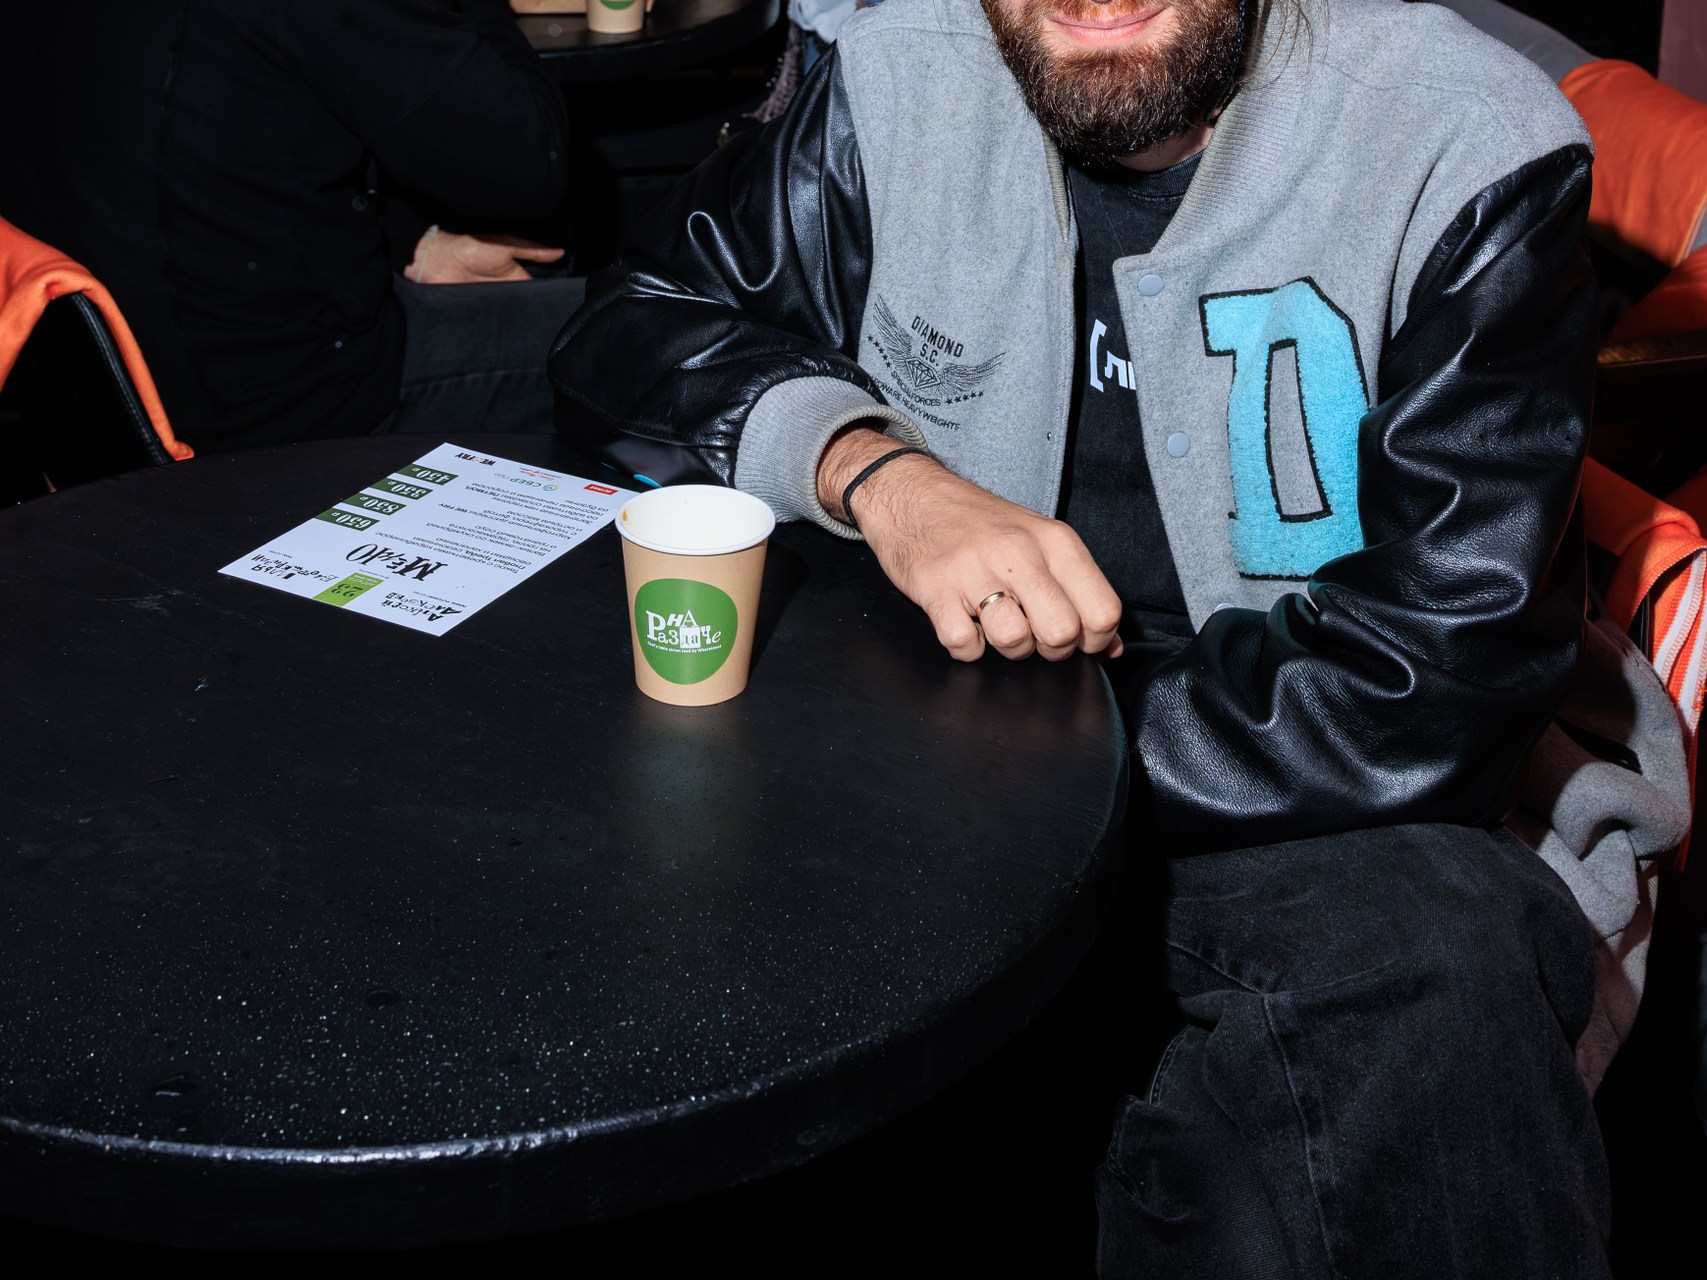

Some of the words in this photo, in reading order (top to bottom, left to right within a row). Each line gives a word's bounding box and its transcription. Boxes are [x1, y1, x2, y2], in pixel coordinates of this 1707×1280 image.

[911, 315, 964, 358] DIAMOND
[919, 343, 940, 367] S.C.
[910, 393, 941, 407] FORCES
[901, 397, 961, 431] HEAVYWEIGHTS
[415, 470, 449, 482] 450
[509, 477, 541, 487] СБЕР
[390, 483, 426, 497] 350
[362, 498, 399, 513] 850
[335, 514, 371, 528] 650
[330, 583, 364, 597] 23
